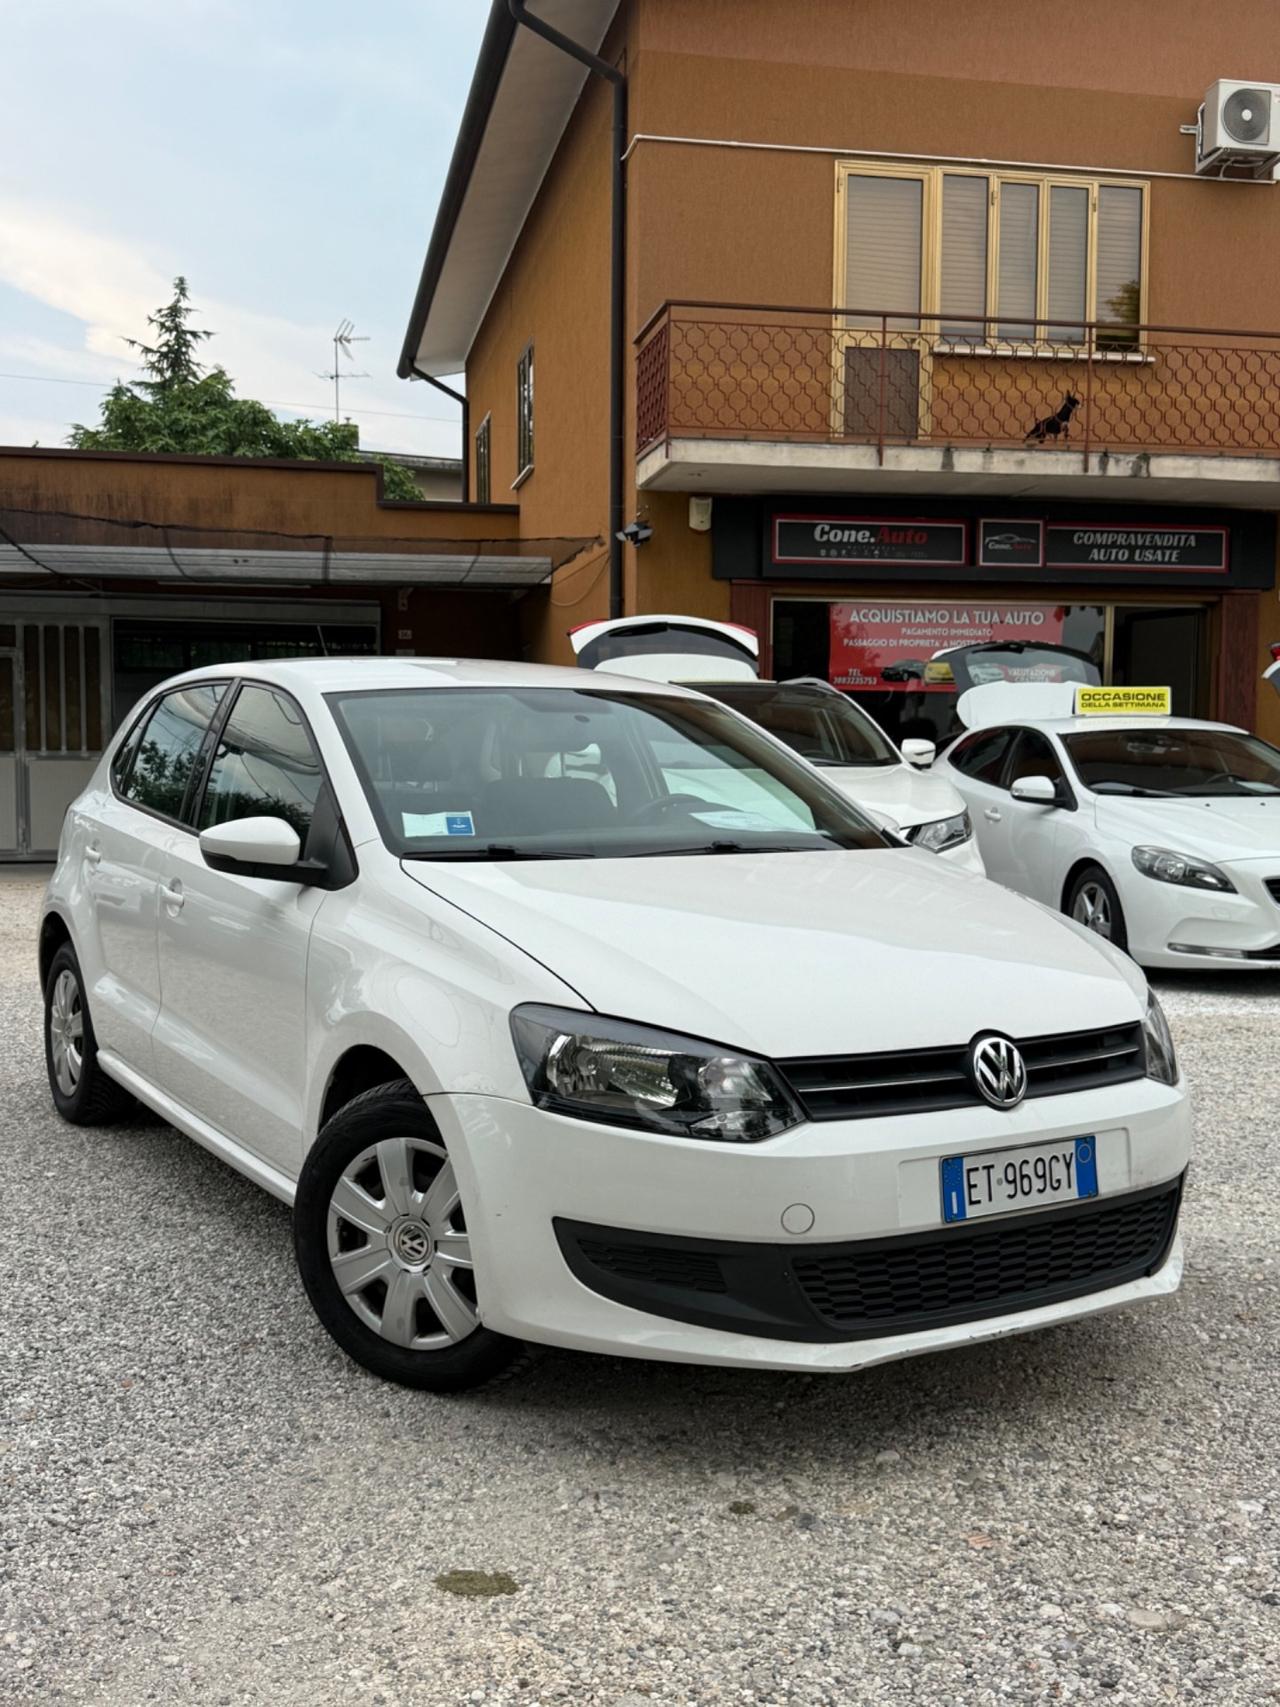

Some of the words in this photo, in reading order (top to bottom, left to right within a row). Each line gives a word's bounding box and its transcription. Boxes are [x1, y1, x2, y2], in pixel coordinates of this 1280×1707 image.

[813, 524, 929, 544] Cone.Auto
[1073, 531, 1197, 547] COMPRAVENDITA
[1088, 548, 1129, 561] AUTO
[1134, 549, 1180, 562] USATE
[850, 609, 949, 624] ACQUISTIAMO
[953, 610, 970, 624] LA
[973, 611, 1000, 625] TUA
[1004, 612, 1044, 625] AUTO
[901, 627, 948, 636] PAGAMENTO
[950, 628, 993, 637] IMMEDIATO
[843, 638, 887, 647] PASSAGGIO
[889, 639, 897, 647] DI
[941, 640, 949, 648] A
[1081, 692, 1166, 701] OCCASIONE
